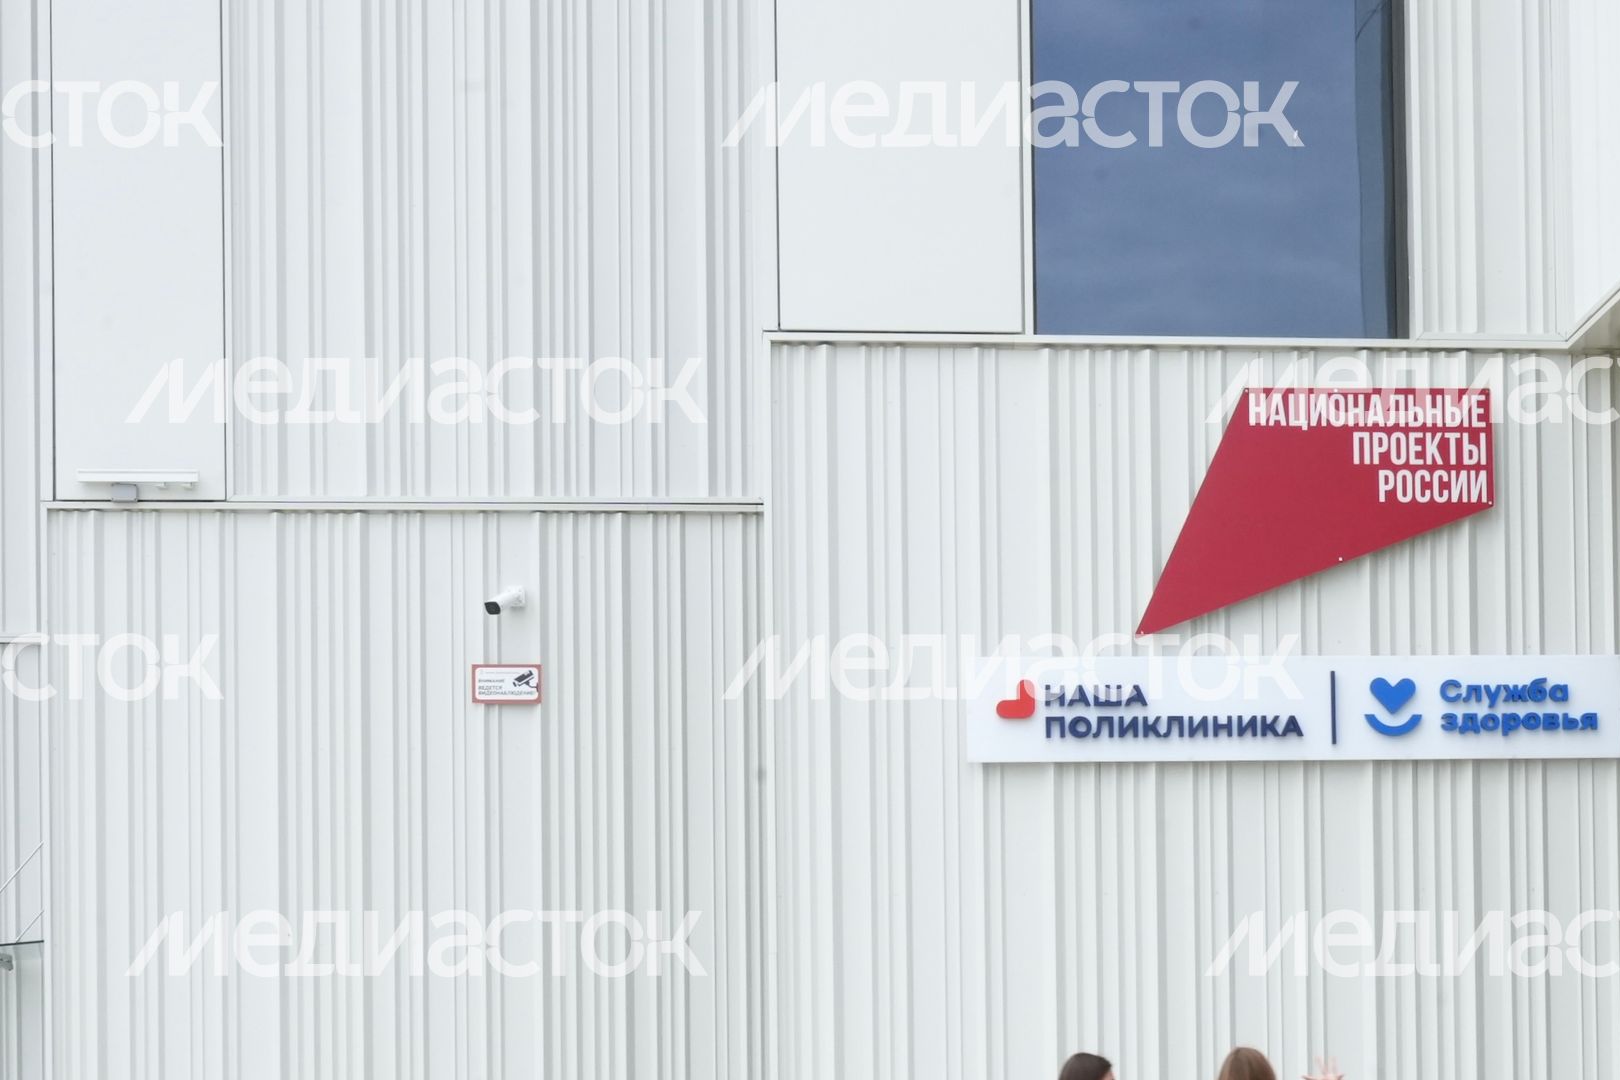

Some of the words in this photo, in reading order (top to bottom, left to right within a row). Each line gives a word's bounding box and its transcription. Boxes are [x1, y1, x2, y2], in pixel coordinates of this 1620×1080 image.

[1249, 393, 1486, 430] НАЦИОНАЛЬНЫЕ
[1353, 432, 1487, 465] ПРОЕКТЫ
[1378, 470, 1487, 503] РОССИИ
[1045, 684, 1148, 707] НАША
[1439, 677, 1569, 709] Служба
[1045, 715, 1304, 739] ПОЛИКЛИНИКА
[1440, 712, 1598, 737] здоровья
